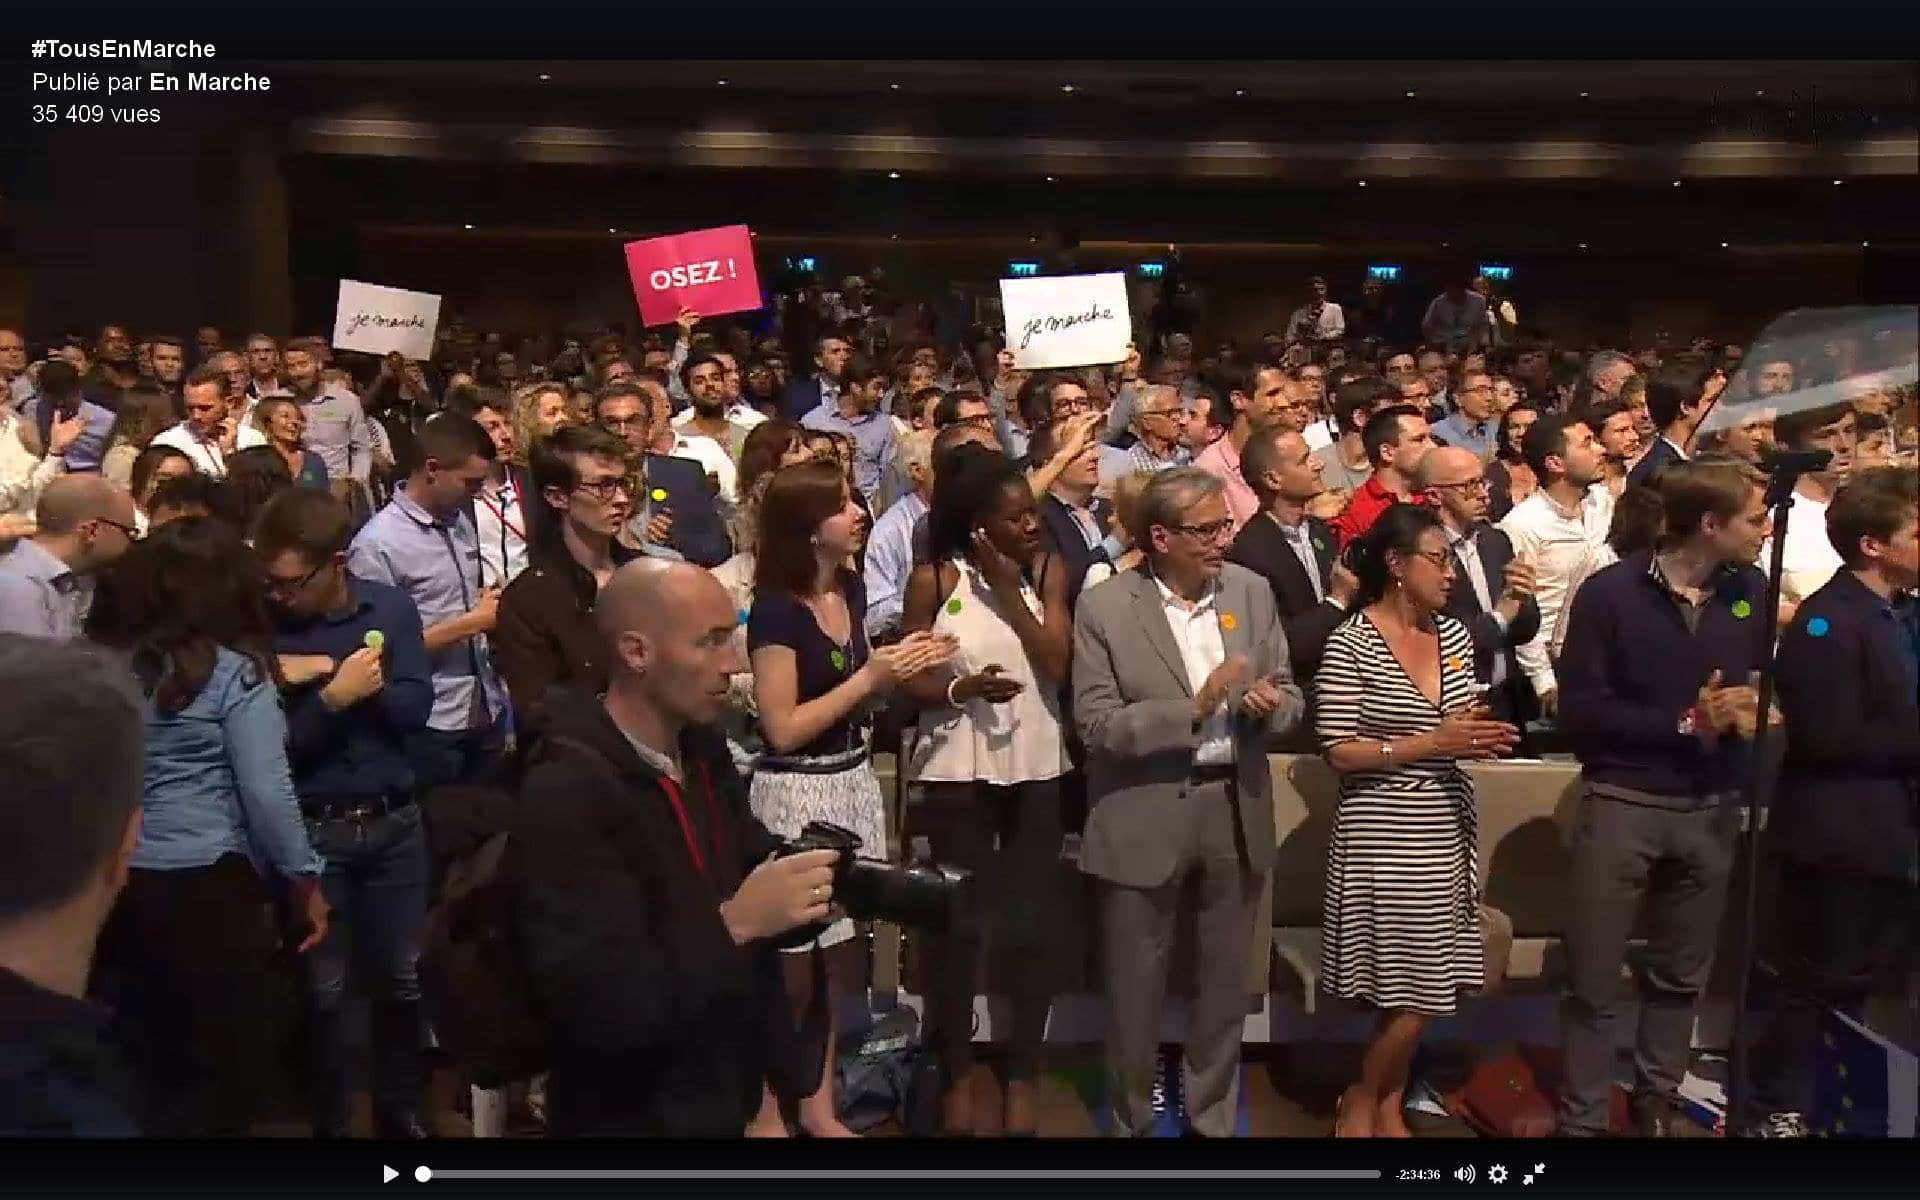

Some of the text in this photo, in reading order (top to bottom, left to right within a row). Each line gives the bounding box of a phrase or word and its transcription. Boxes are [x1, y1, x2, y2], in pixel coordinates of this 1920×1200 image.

[650, 258, 737, 290] OSEZ !
[1020, 303, 1114, 350] je marche
